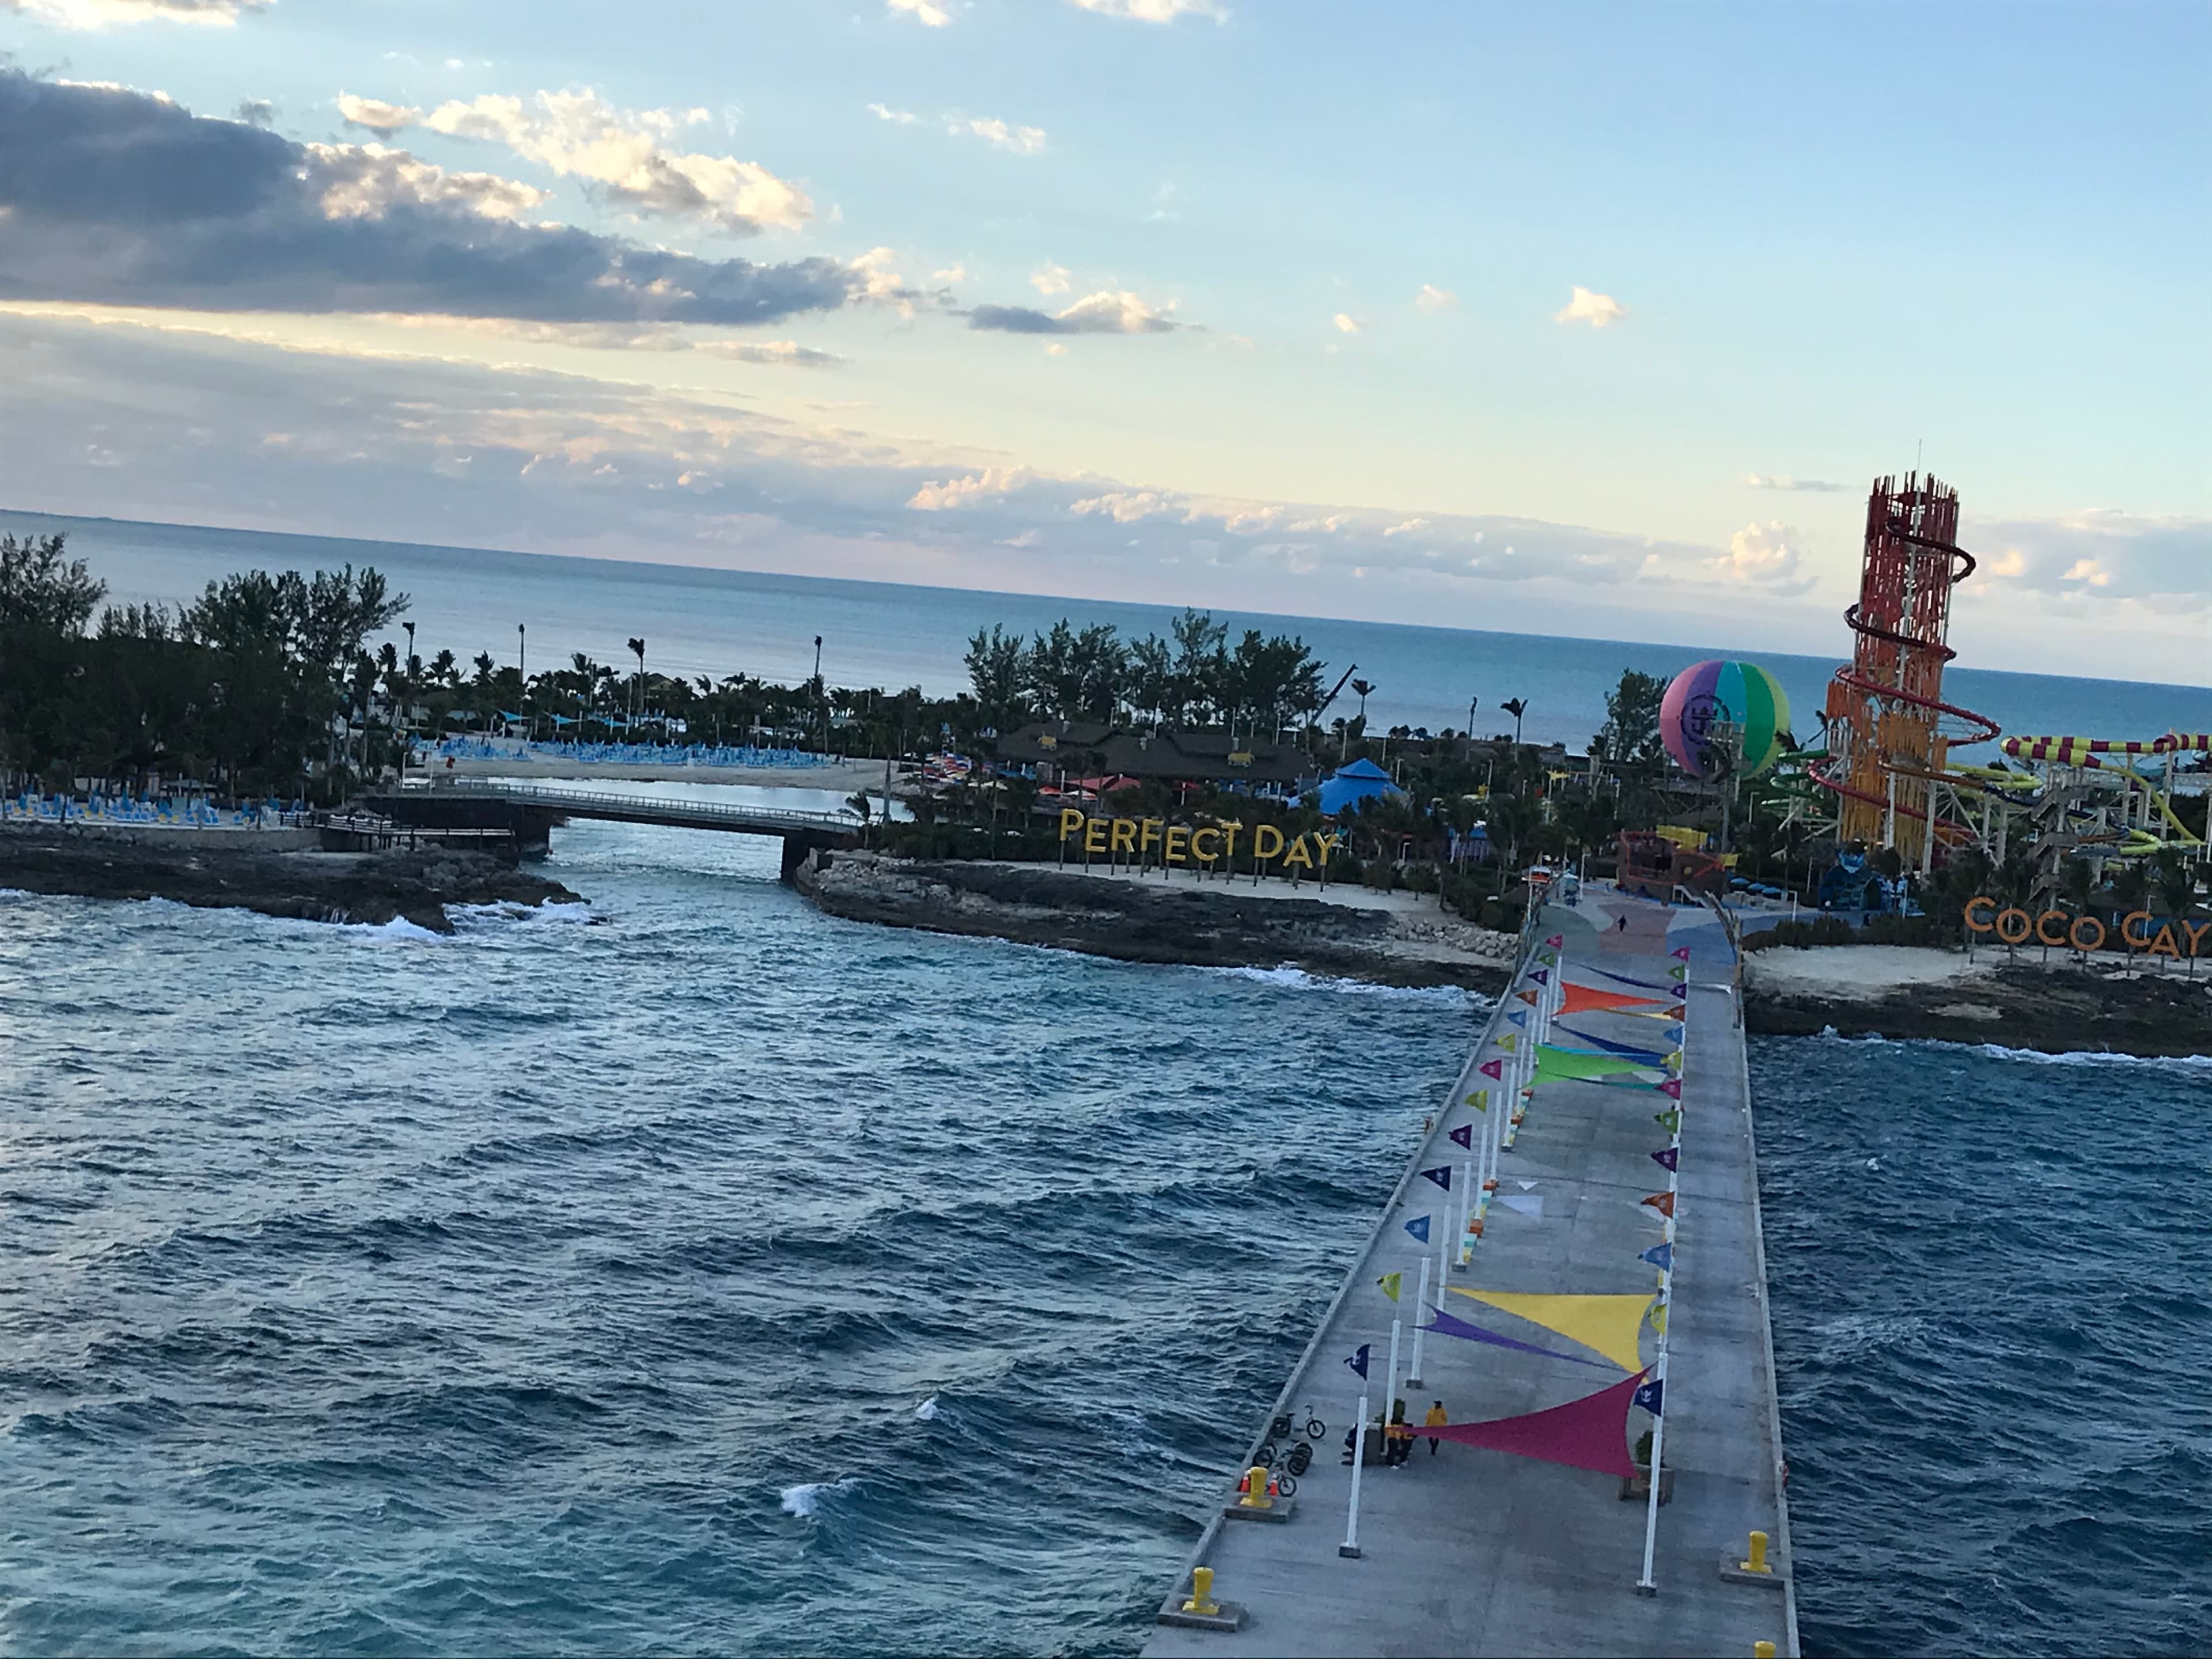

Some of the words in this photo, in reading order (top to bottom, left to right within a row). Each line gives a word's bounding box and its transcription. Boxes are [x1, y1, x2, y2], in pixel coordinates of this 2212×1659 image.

[1060, 808, 1243, 861] PERFECT
[1254, 825, 1340, 869] DAY
[1964, 896, 2105, 951] COCO
[2122, 911, 2211, 960] CAY
